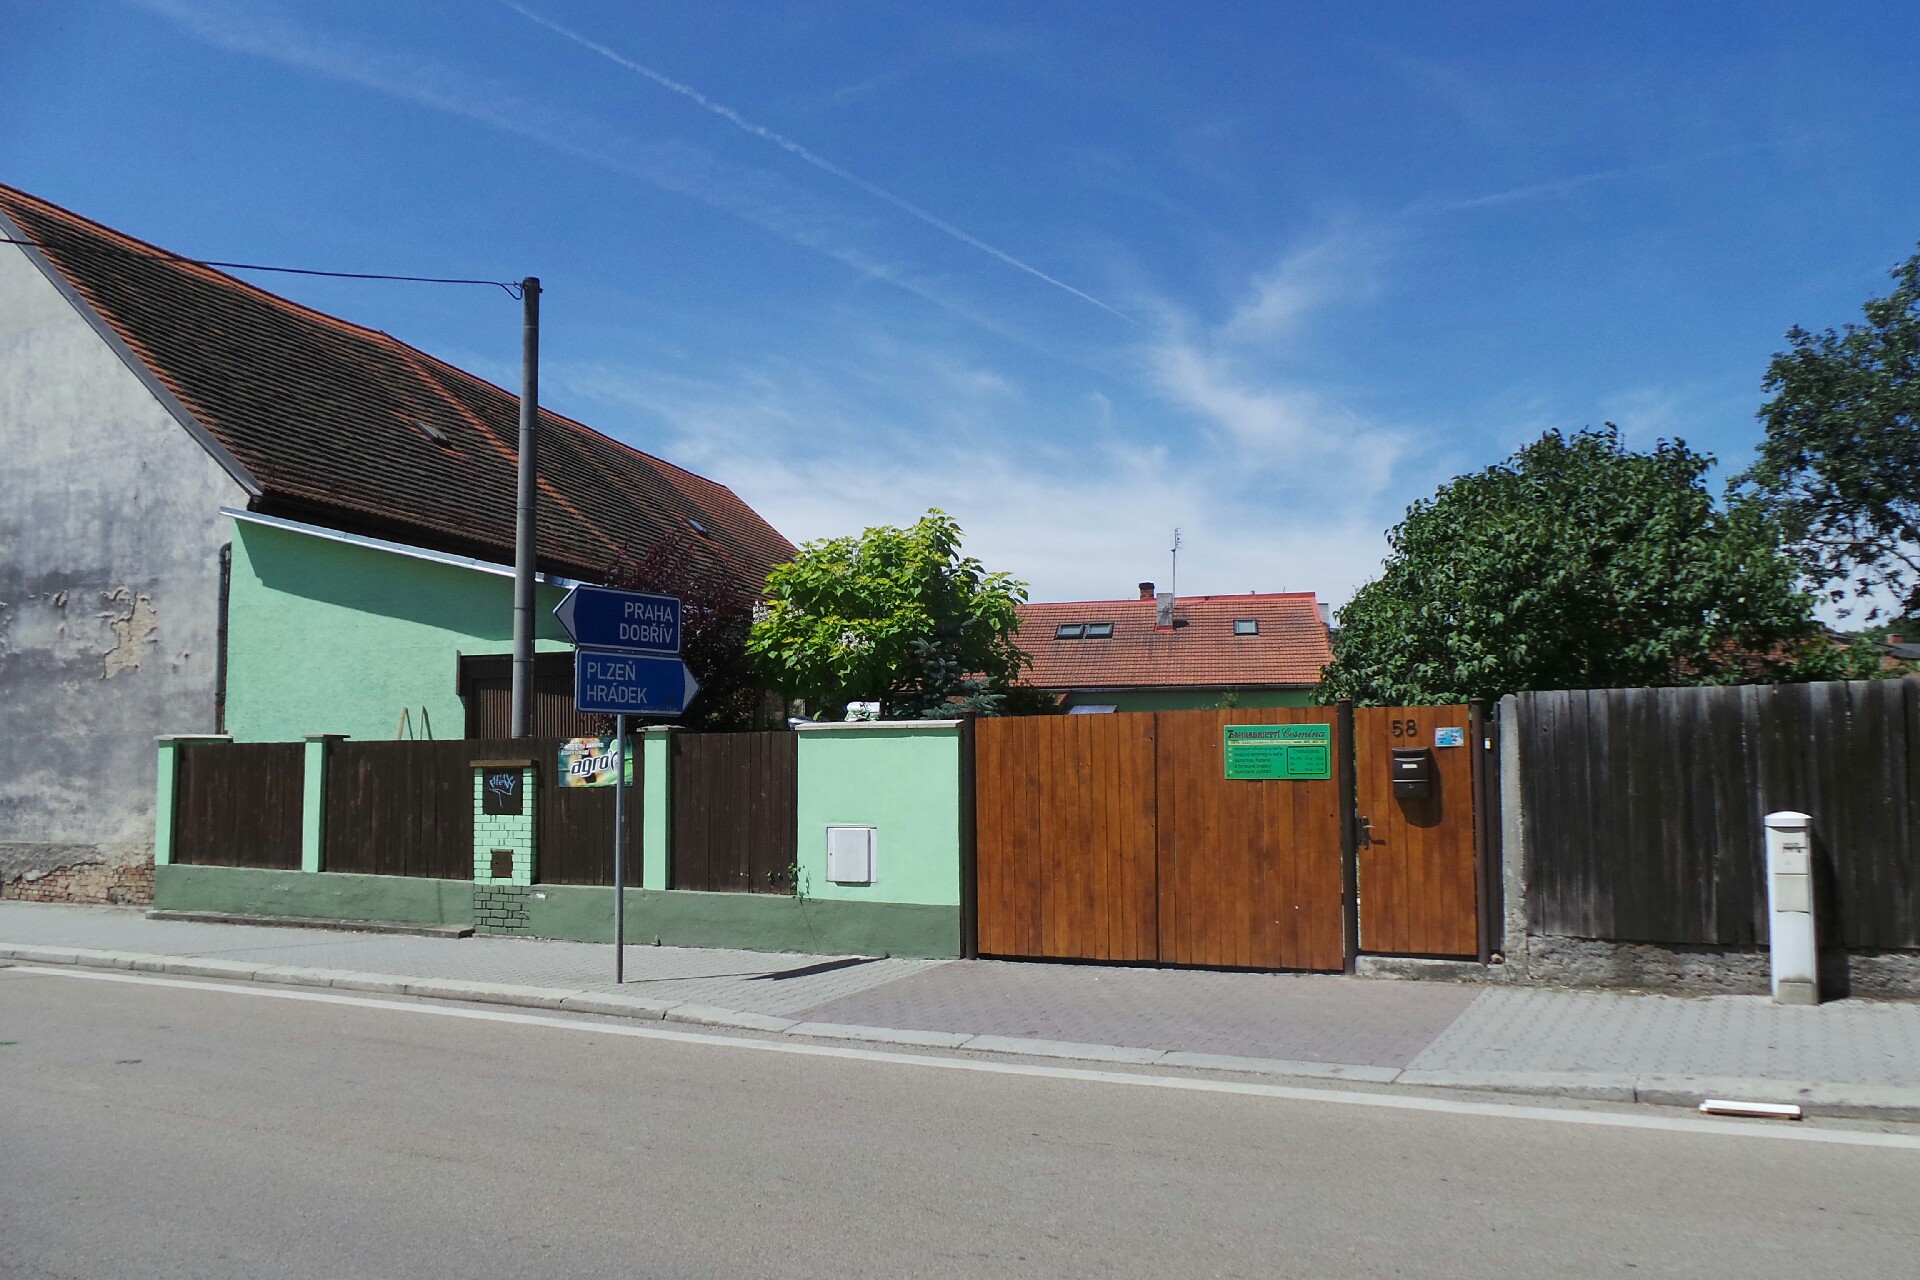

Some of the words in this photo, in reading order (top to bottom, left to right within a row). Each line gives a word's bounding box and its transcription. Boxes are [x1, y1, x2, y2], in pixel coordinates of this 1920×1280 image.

[624, 601, 674, 623] PRAHA
[619, 623, 673, 644] DOBŘÍV
[586, 660, 636, 681] PLZEŇ
[586, 683, 648, 704] HRÁDEK
[1392, 719, 1417, 738] 58
